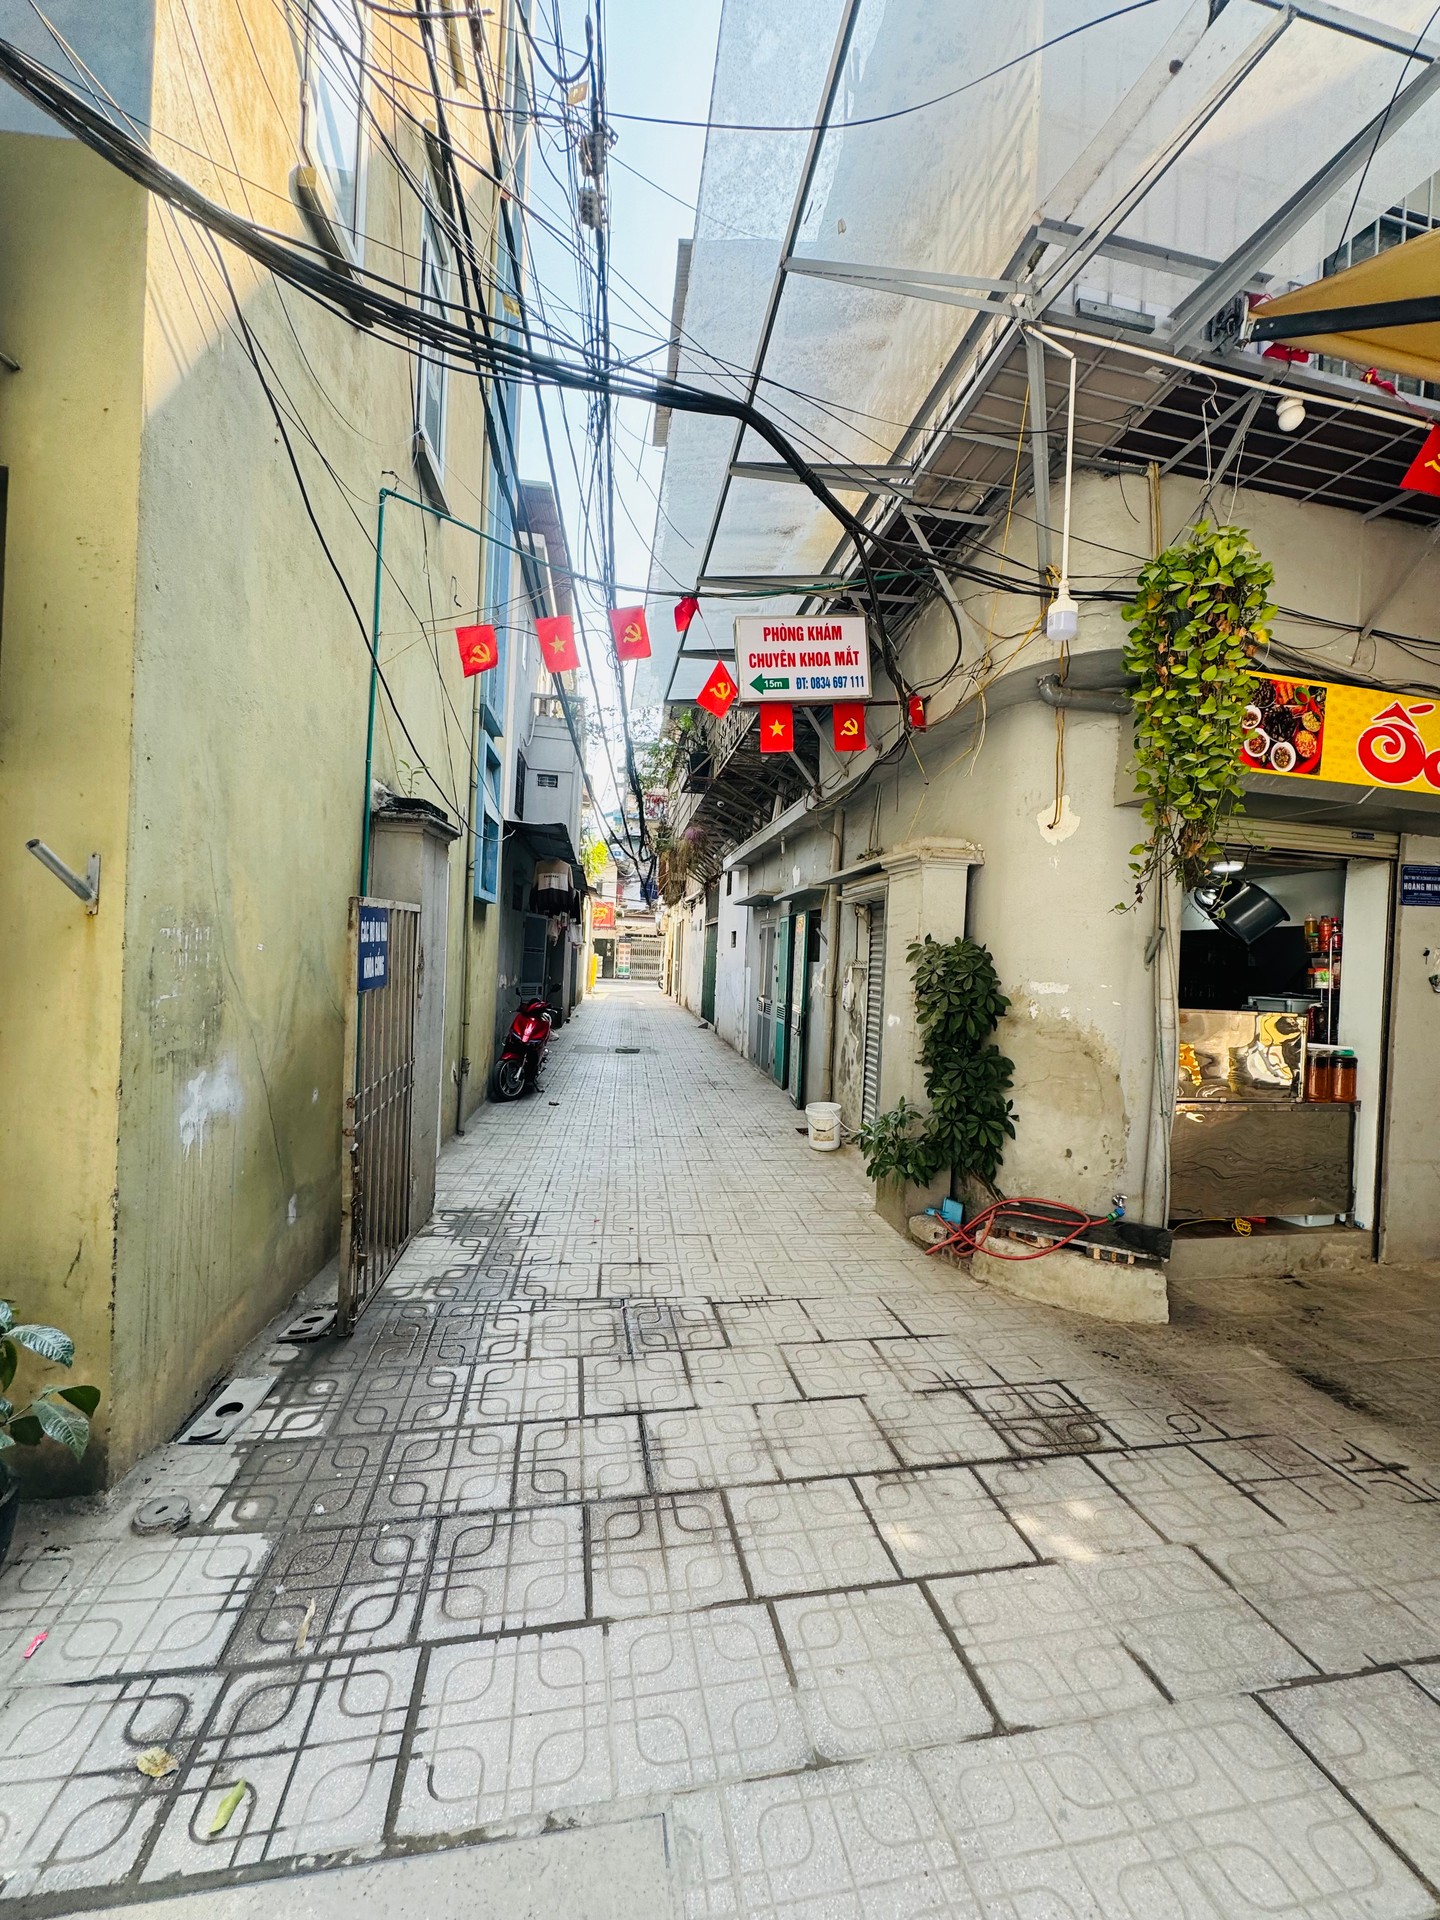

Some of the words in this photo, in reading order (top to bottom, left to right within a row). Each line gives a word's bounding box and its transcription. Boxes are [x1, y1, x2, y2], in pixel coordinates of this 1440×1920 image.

[763, 623, 804, 642] PHÒNG
[807, 623, 842, 641] KHÁM
[748, 649, 796, 668] CHUYÊN
[799, 651, 831, 668] KHOA
[834, 645, 860, 666] MẮT
[764, 680, 783, 688] 15m
[796, 677, 809, 690] ĐT:
[811, 676, 831, 689] 0834
[833, 676, 848, 689] 697
[850, 675, 865, 688] 111
[1403, 881, 1425, 891] HOÀNG
